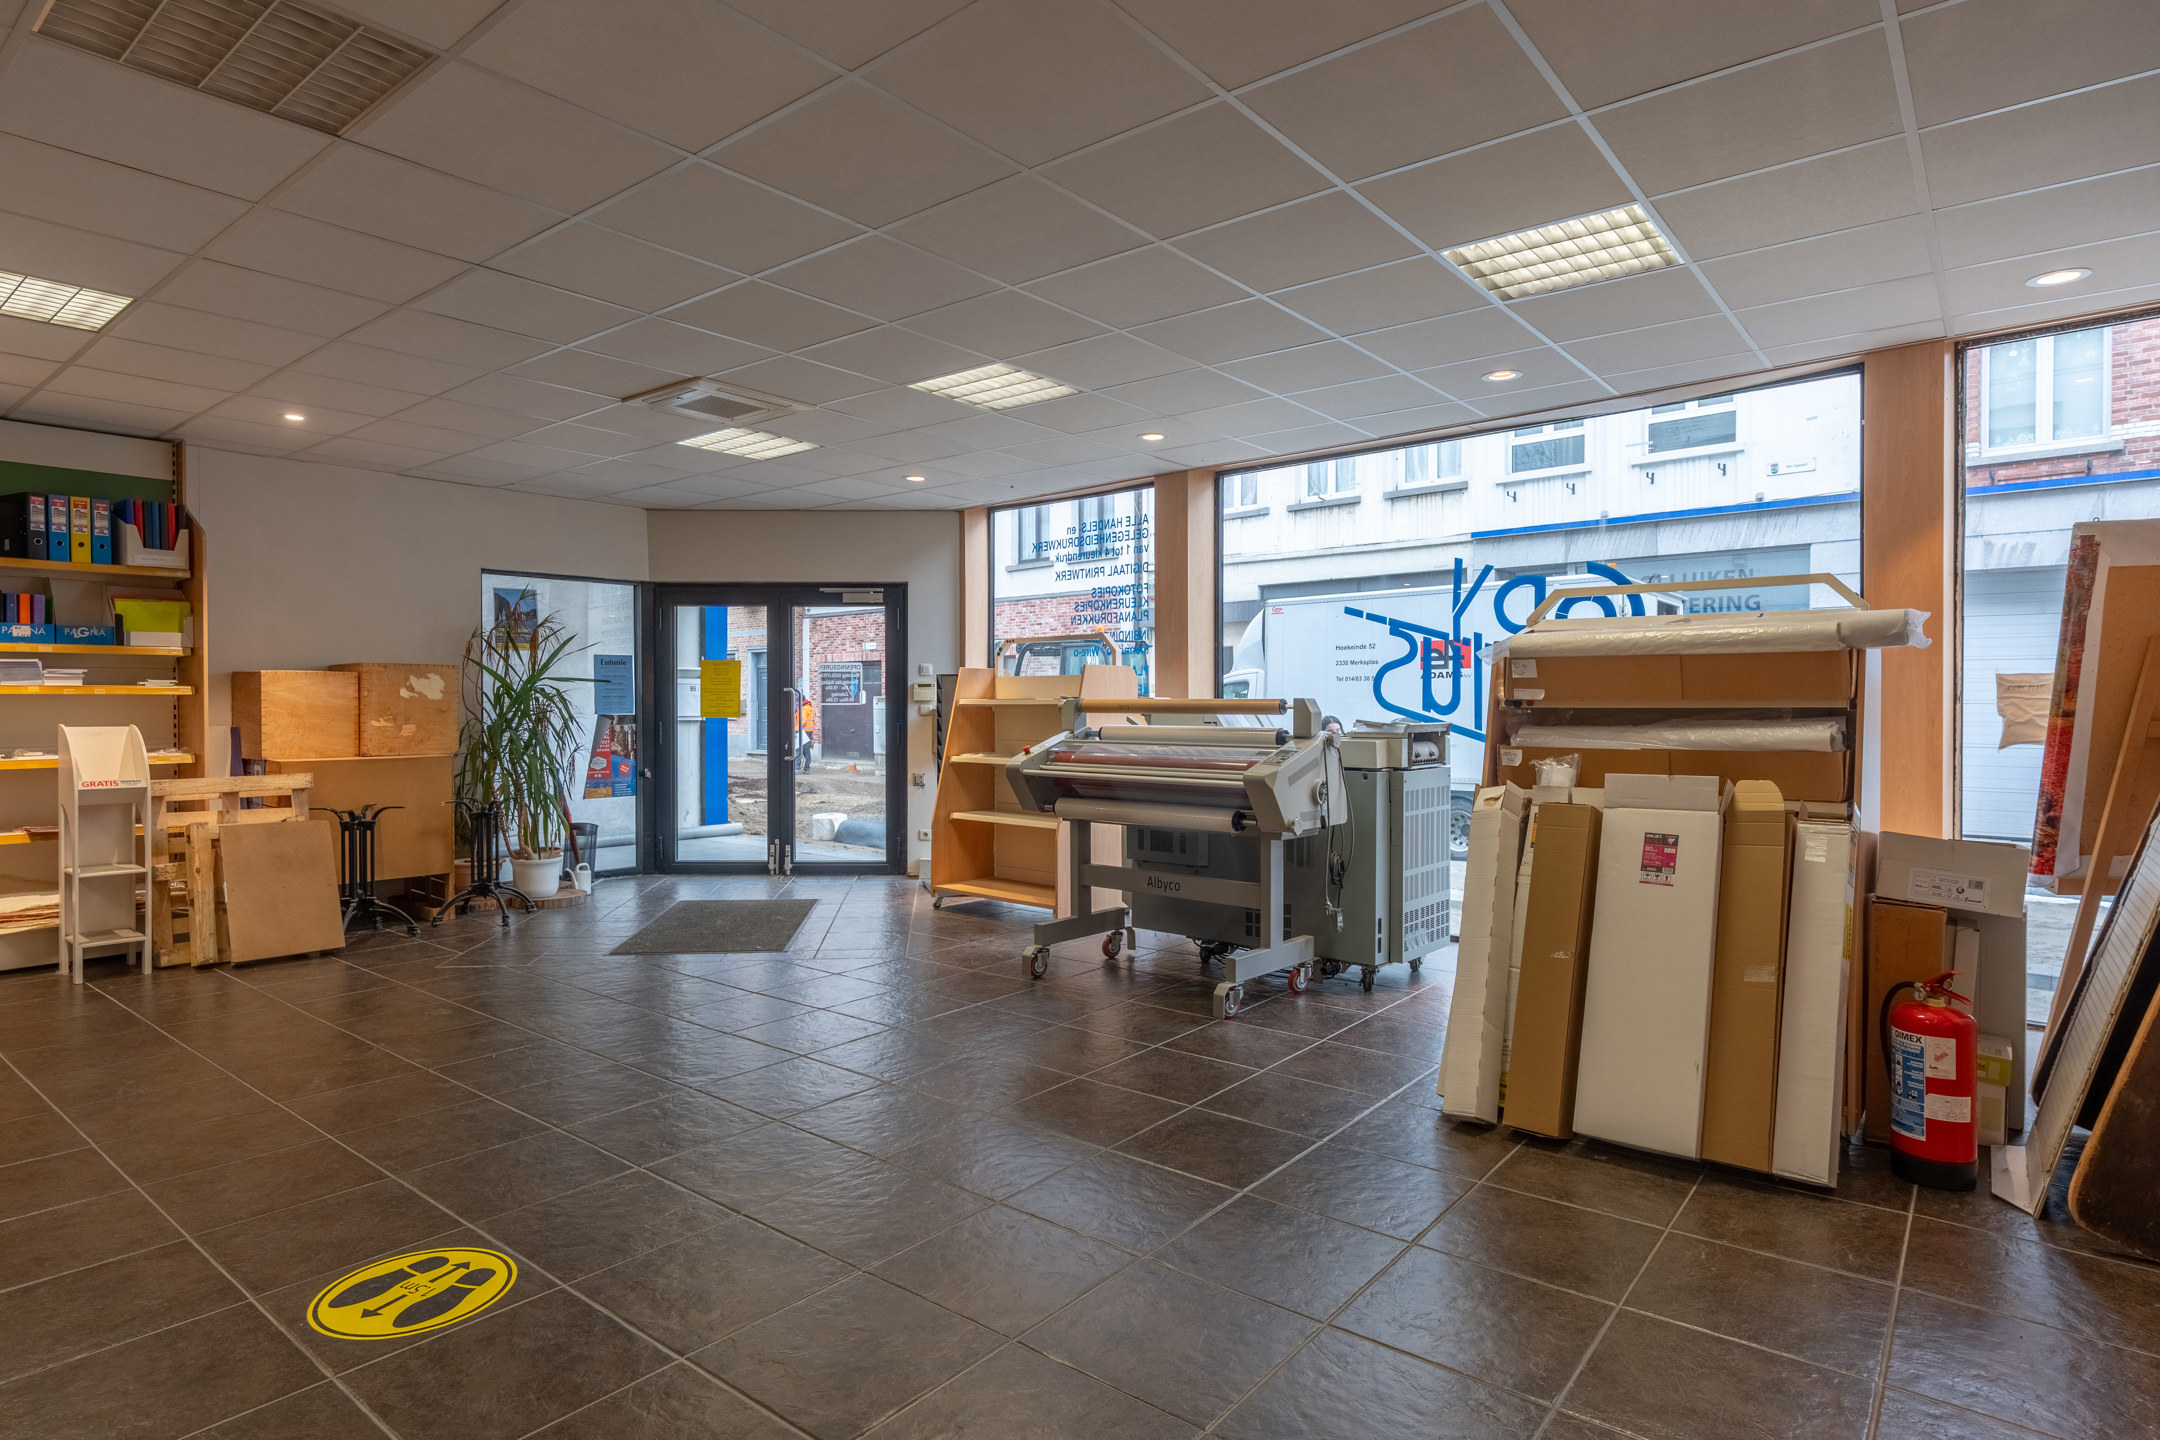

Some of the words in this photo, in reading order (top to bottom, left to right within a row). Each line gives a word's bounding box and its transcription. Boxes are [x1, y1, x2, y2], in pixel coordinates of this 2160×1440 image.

[1688, 594, 1760, 614] ERING
[1, 626, 46, 635] PANA
[600, 658, 627, 666] Eutonie
[1147, 876, 1181, 892] Albyco
[1894, 1030, 1923, 1044] DIMEX
[399, 1280, 437, 1297] 1.5m
